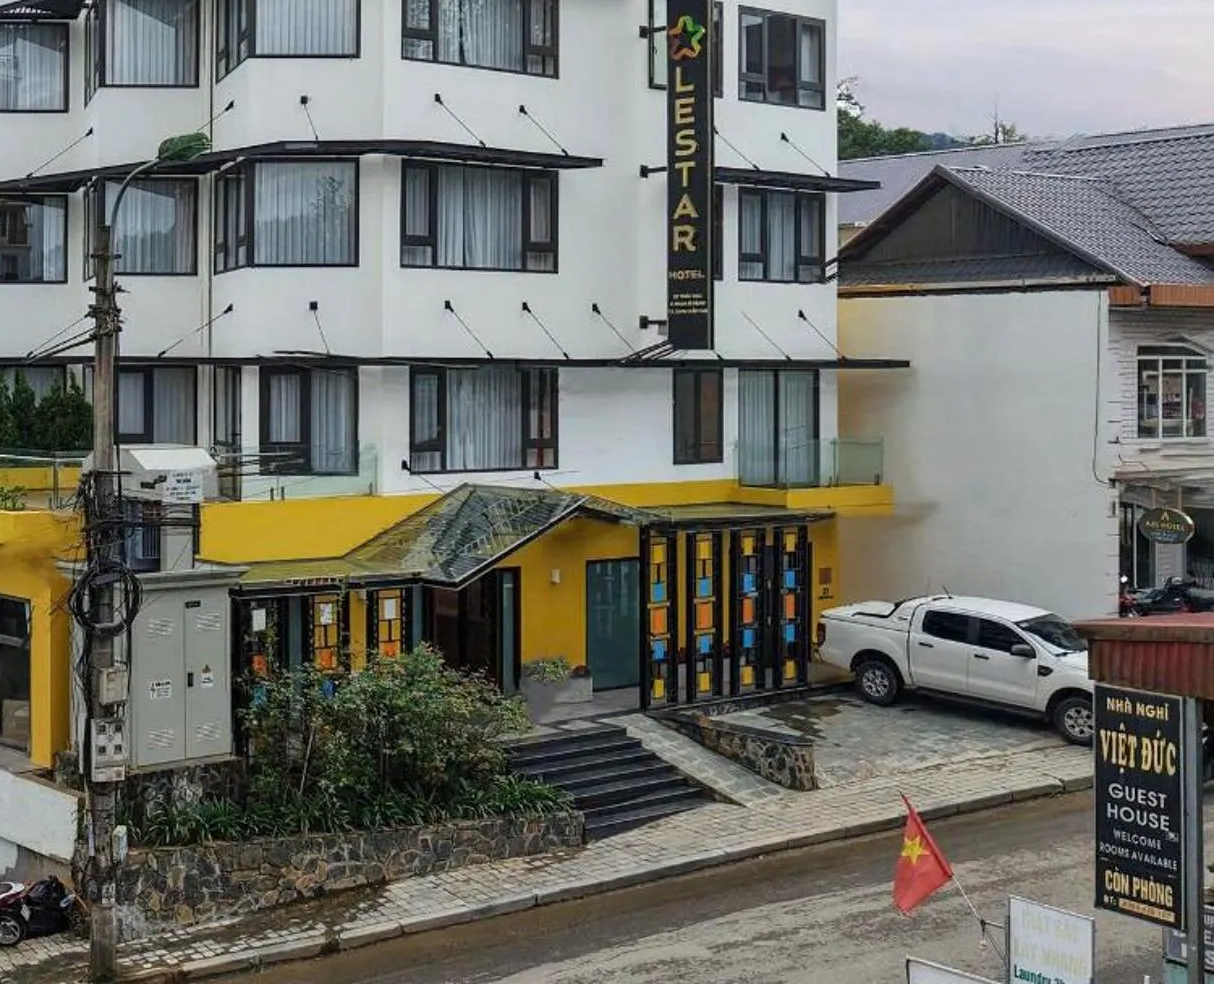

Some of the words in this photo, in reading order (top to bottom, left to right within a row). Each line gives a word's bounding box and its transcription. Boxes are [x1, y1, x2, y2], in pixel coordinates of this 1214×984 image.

[672, 67, 700, 252] LESTAR
[668, 270, 705, 280] HOTEL
[1106, 696, 1132, 714] NHÀ
[1100, 722, 1137, 774] VIỆT
[1141, 729, 1176, 776] ĐỨC
[1108, 782, 1167, 809] GUEST
[1107, 802, 1170, 831] HOUSE
[1113, 828, 1162, 850] WELCOME
[1099, 841, 1130, 858] ROOMS
[1131, 850, 1178, 871] AVAILABLE
[1105, 866, 1130, 896] CÒN
[1132, 875, 1173, 907] PHÒNG
